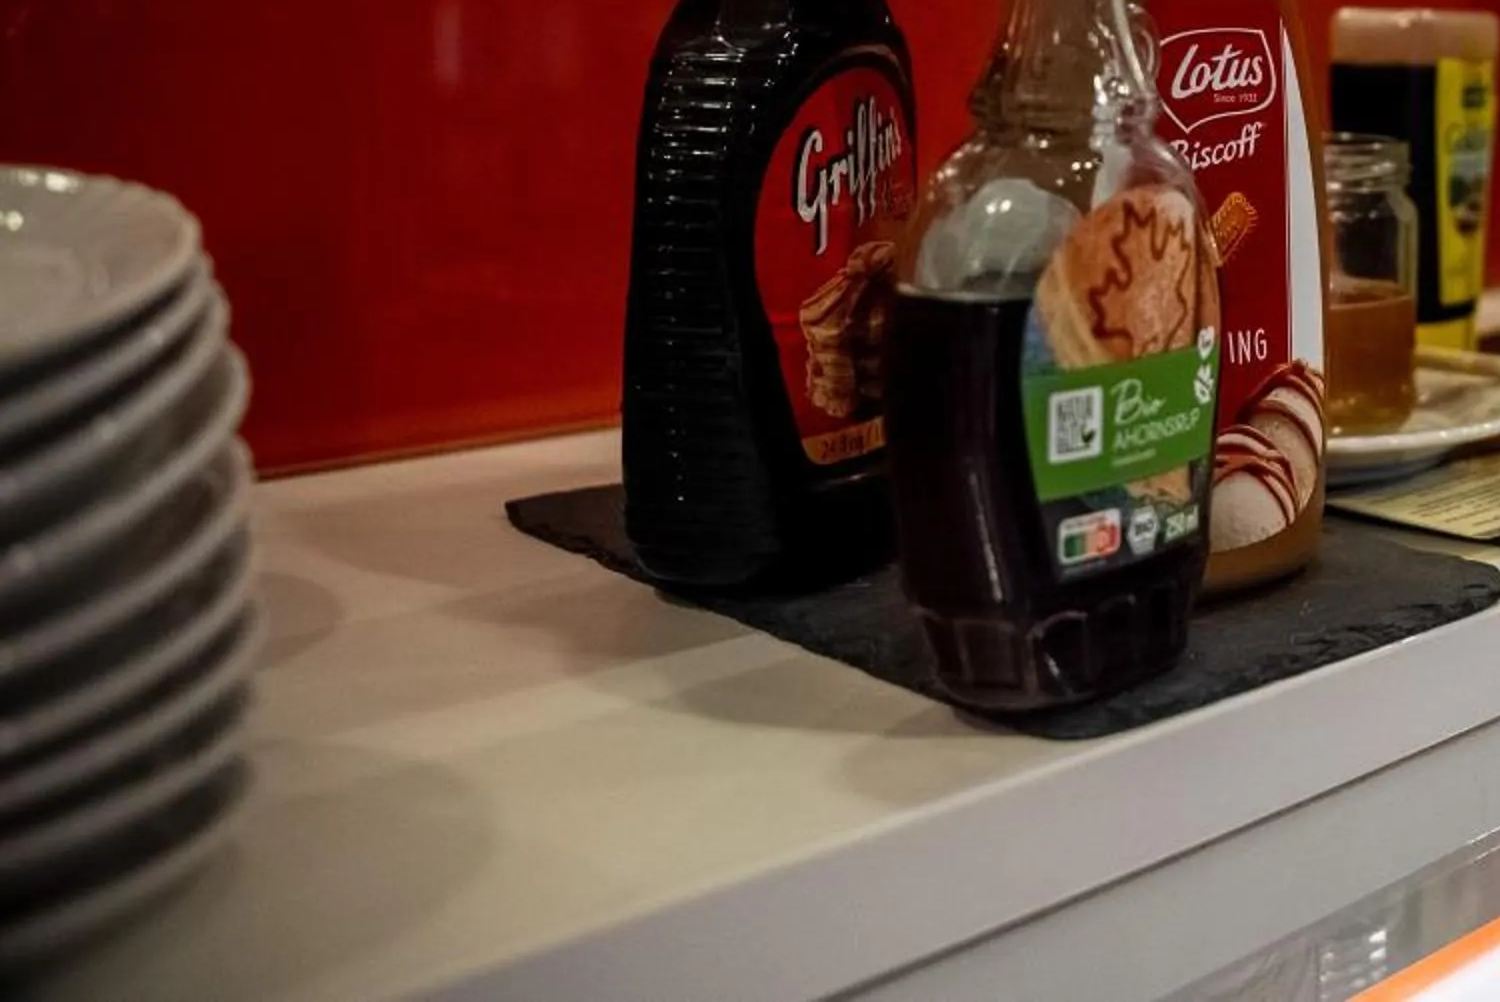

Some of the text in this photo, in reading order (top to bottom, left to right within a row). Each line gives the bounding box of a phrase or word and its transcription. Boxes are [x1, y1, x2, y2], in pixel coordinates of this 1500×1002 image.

[1171, 43, 1264, 100] Lotus
[1170, 121, 1263, 171] Biscoff
[1227, 327, 1268, 366] ING
[1110, 377, 1167, 426] Bio
